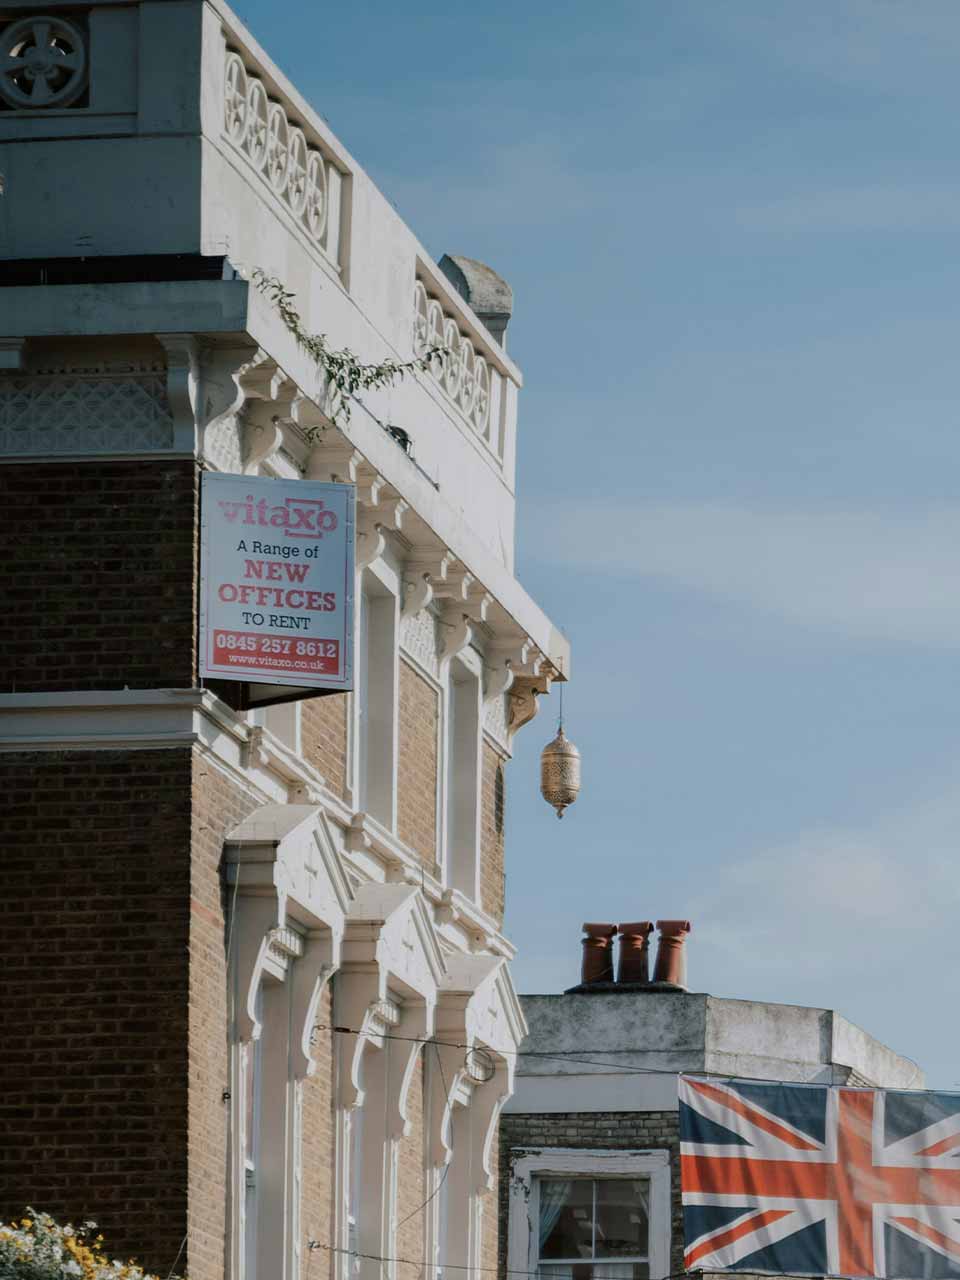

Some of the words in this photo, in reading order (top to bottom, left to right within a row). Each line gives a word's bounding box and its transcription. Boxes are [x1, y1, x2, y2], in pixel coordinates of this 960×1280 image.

[218, 495, 338, 534] vitaxo
[237, 540, 247, 552] A
[252, 541, 299, 558] Range
[304, 545, 320, 558] of
[243, 560, 310, 583] NEW
[218, 584, 336, 611] OFFICES
[242, 612, 264, 625] TO
[270, 616, 310, 630] RENT
[217, 634, 257, 651] 0845
[261, 638, 291, 654] 257
[296, 642, 336, 657] 8612
[228, 654, 324, 670] www.vitaxo.co.uk
